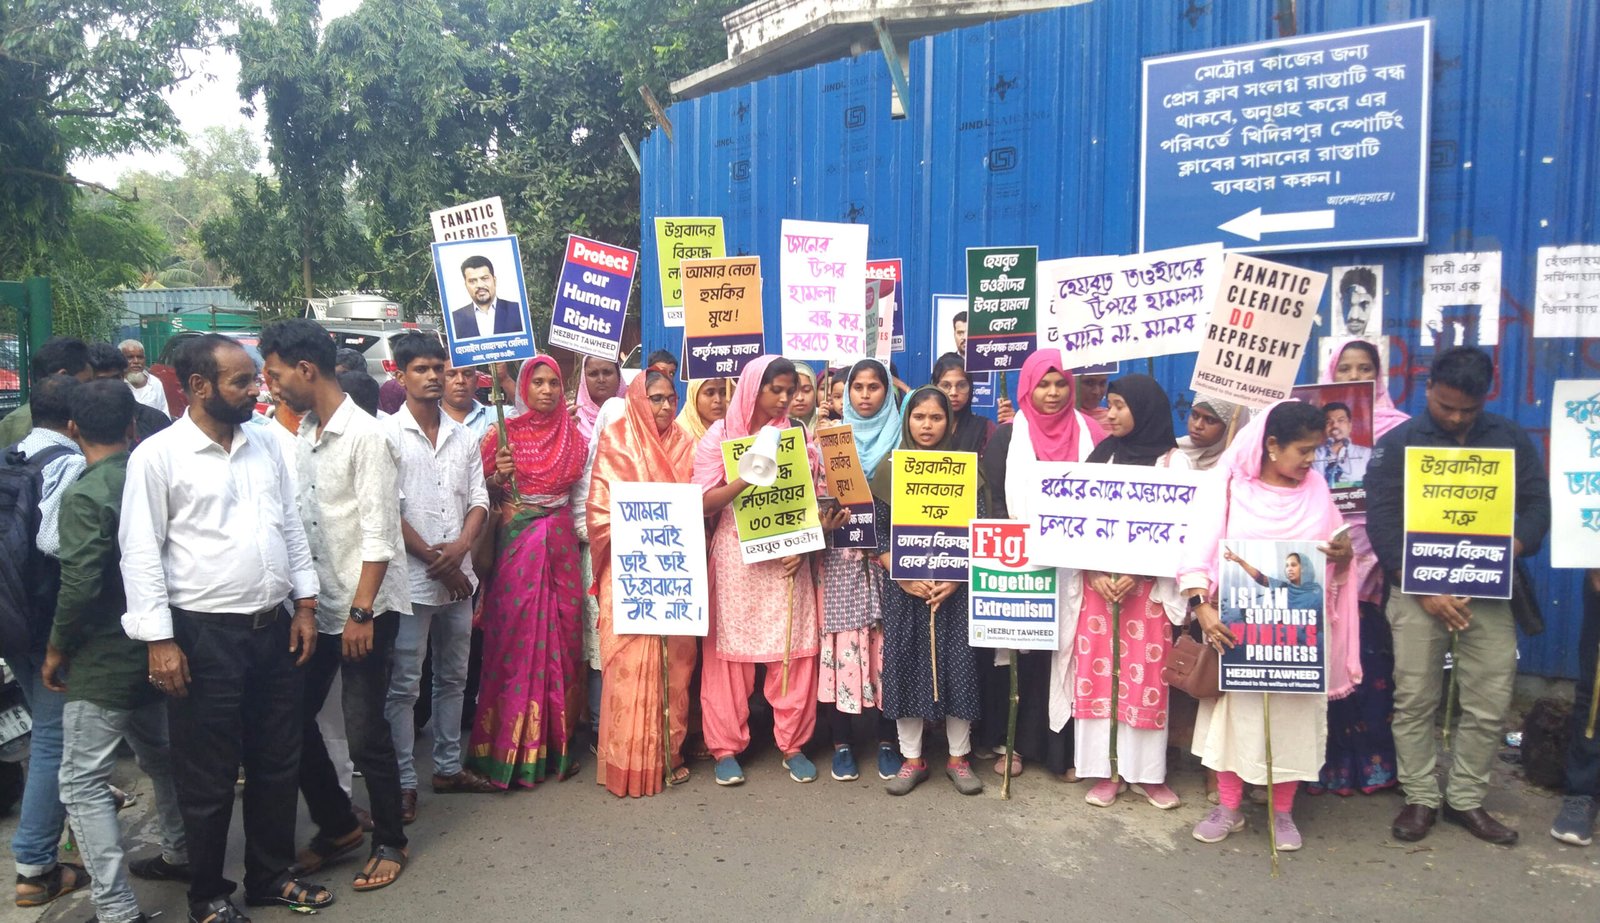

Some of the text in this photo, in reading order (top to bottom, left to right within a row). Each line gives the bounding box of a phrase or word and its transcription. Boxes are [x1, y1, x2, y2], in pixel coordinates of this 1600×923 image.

[1195, 44, 1369, 81] মেট্রোর কাজের জন্য
[1163, 64, 1406, 109] প্রেস ক্লাব সংলগ্ন রাস্তাটি বন্ধ
[1174, 91, 1387, 129] থাকবে, অনুগ্রহ করে এর
[1160, 109, 1405, 154] পরিবর্তে খিদিরপুর স্পোর্টিং
[1178, 137, 1381, 178] ক্লাবের সামনের রাস্তাটি
[1212, 175, 1276, 195] ব্যবহার
[440, 203, 494, 229] FANATIC
[664, 221, 716, 238] উগ্রবাদের
[573, 242, 629, 271] Protect
[672, 243, 713, 259] বিরুদ্ধে
[686, 264, 726, 279] আমার
[728, 262, 757, 276] নেতা
[808, 257, 847, 278] উপর
[983, 254, 1019, 271] হেযবুত
[1430, 261, 1481, 275] দাবী এক
[583, 271, 609, 288] our
[980, 274, 1026, 292] তওহীদের
[1234, 261, 1311, 295] FANATIC
[1430, 282, 1481, 293] দফা এক
[563, 281, 621, 312] Human
[700, 283, 746, 303] হুমকির
[787, 285, 837, 304] হামলা
[1143, 285, 1204, 311] হামলা
[1227, 285, 1304, 318] CLERICS
[974, 297, 1030, 313] উপর হামলা
[564, 307, 612, 334] Rights
[809, 310, 832, 328] বন্ধ
[989, 318, 1018, 331] কেন?
[1229, 308, 1254, 329] DO
[553, 328, 580, 341] HEZBUT
[581, 336, 616, 351] TAWHEED
[785, 332, 830, 352] করতে
[1063, 324, 1104, 351] মানি
[1142, 313, 1197, 339] মানব
[1208, 324, 1301, 359] REPRESENT
[692, 342, 760, 361] কর্তৃপক্ষ জবাব
[1216, 348, 1272, 378] ISLAM
[1197, 370, 1285, 400] HEZBUT TAWHEED
[820, 431, 852, 447] আমার নেতা
[904, 457, 967, 476] উগ্রবাদীরা
[1421, 455, 1500, 475] উগ্রবাদীরা
[905, 482, 965, 498] মানবতার
[1042, 471, 1090, 500] ধর্মের
[1090, 480, 1125, 500] নামে
[1422, 484, 1499, 502] মানবতার
[617, 502, 672, 521] আমরা
[750, 508, 806, 531] ৩০ বছর
[921, 505, 950, 519] শত্রু
[1442, 509, 1478, 526] শত্রু
[641, 525, 684, 547] সবাই
[1038, 514, 1088, 538] চলবে
[1096, 518, 1119, 539] না
[1126, 520, 1175, 544] চলবে
[784, 532, 819, 547] তওহীদ
[897, 535, 933, 548] তাদের
[899, 552, 969, 569] হোক প্রতিবাদ
[1412, 540, 1506, 562] তাদের বিরুদ্ধে
[617, 550, 689, 573] ভাই ভাই
[979, 572, 1052, 592] Together
[1413, 564, 1503, 584] হোক প্রতিবাদ
[618, 574, 693, 596] উগ্রবাদের
[1230, 586, 1288, 609] ISLAM
[975, 598, 1053, 618] Extremism
[1245, 608, 1317, 626] SUPPORTS
[987, 627, 1054, 637] HEZBUT TAWHEED
[1246, 644, 1318, 662] PROGRESS
[1226, 668, 1320, 680] HEZBUT TAWHEED
